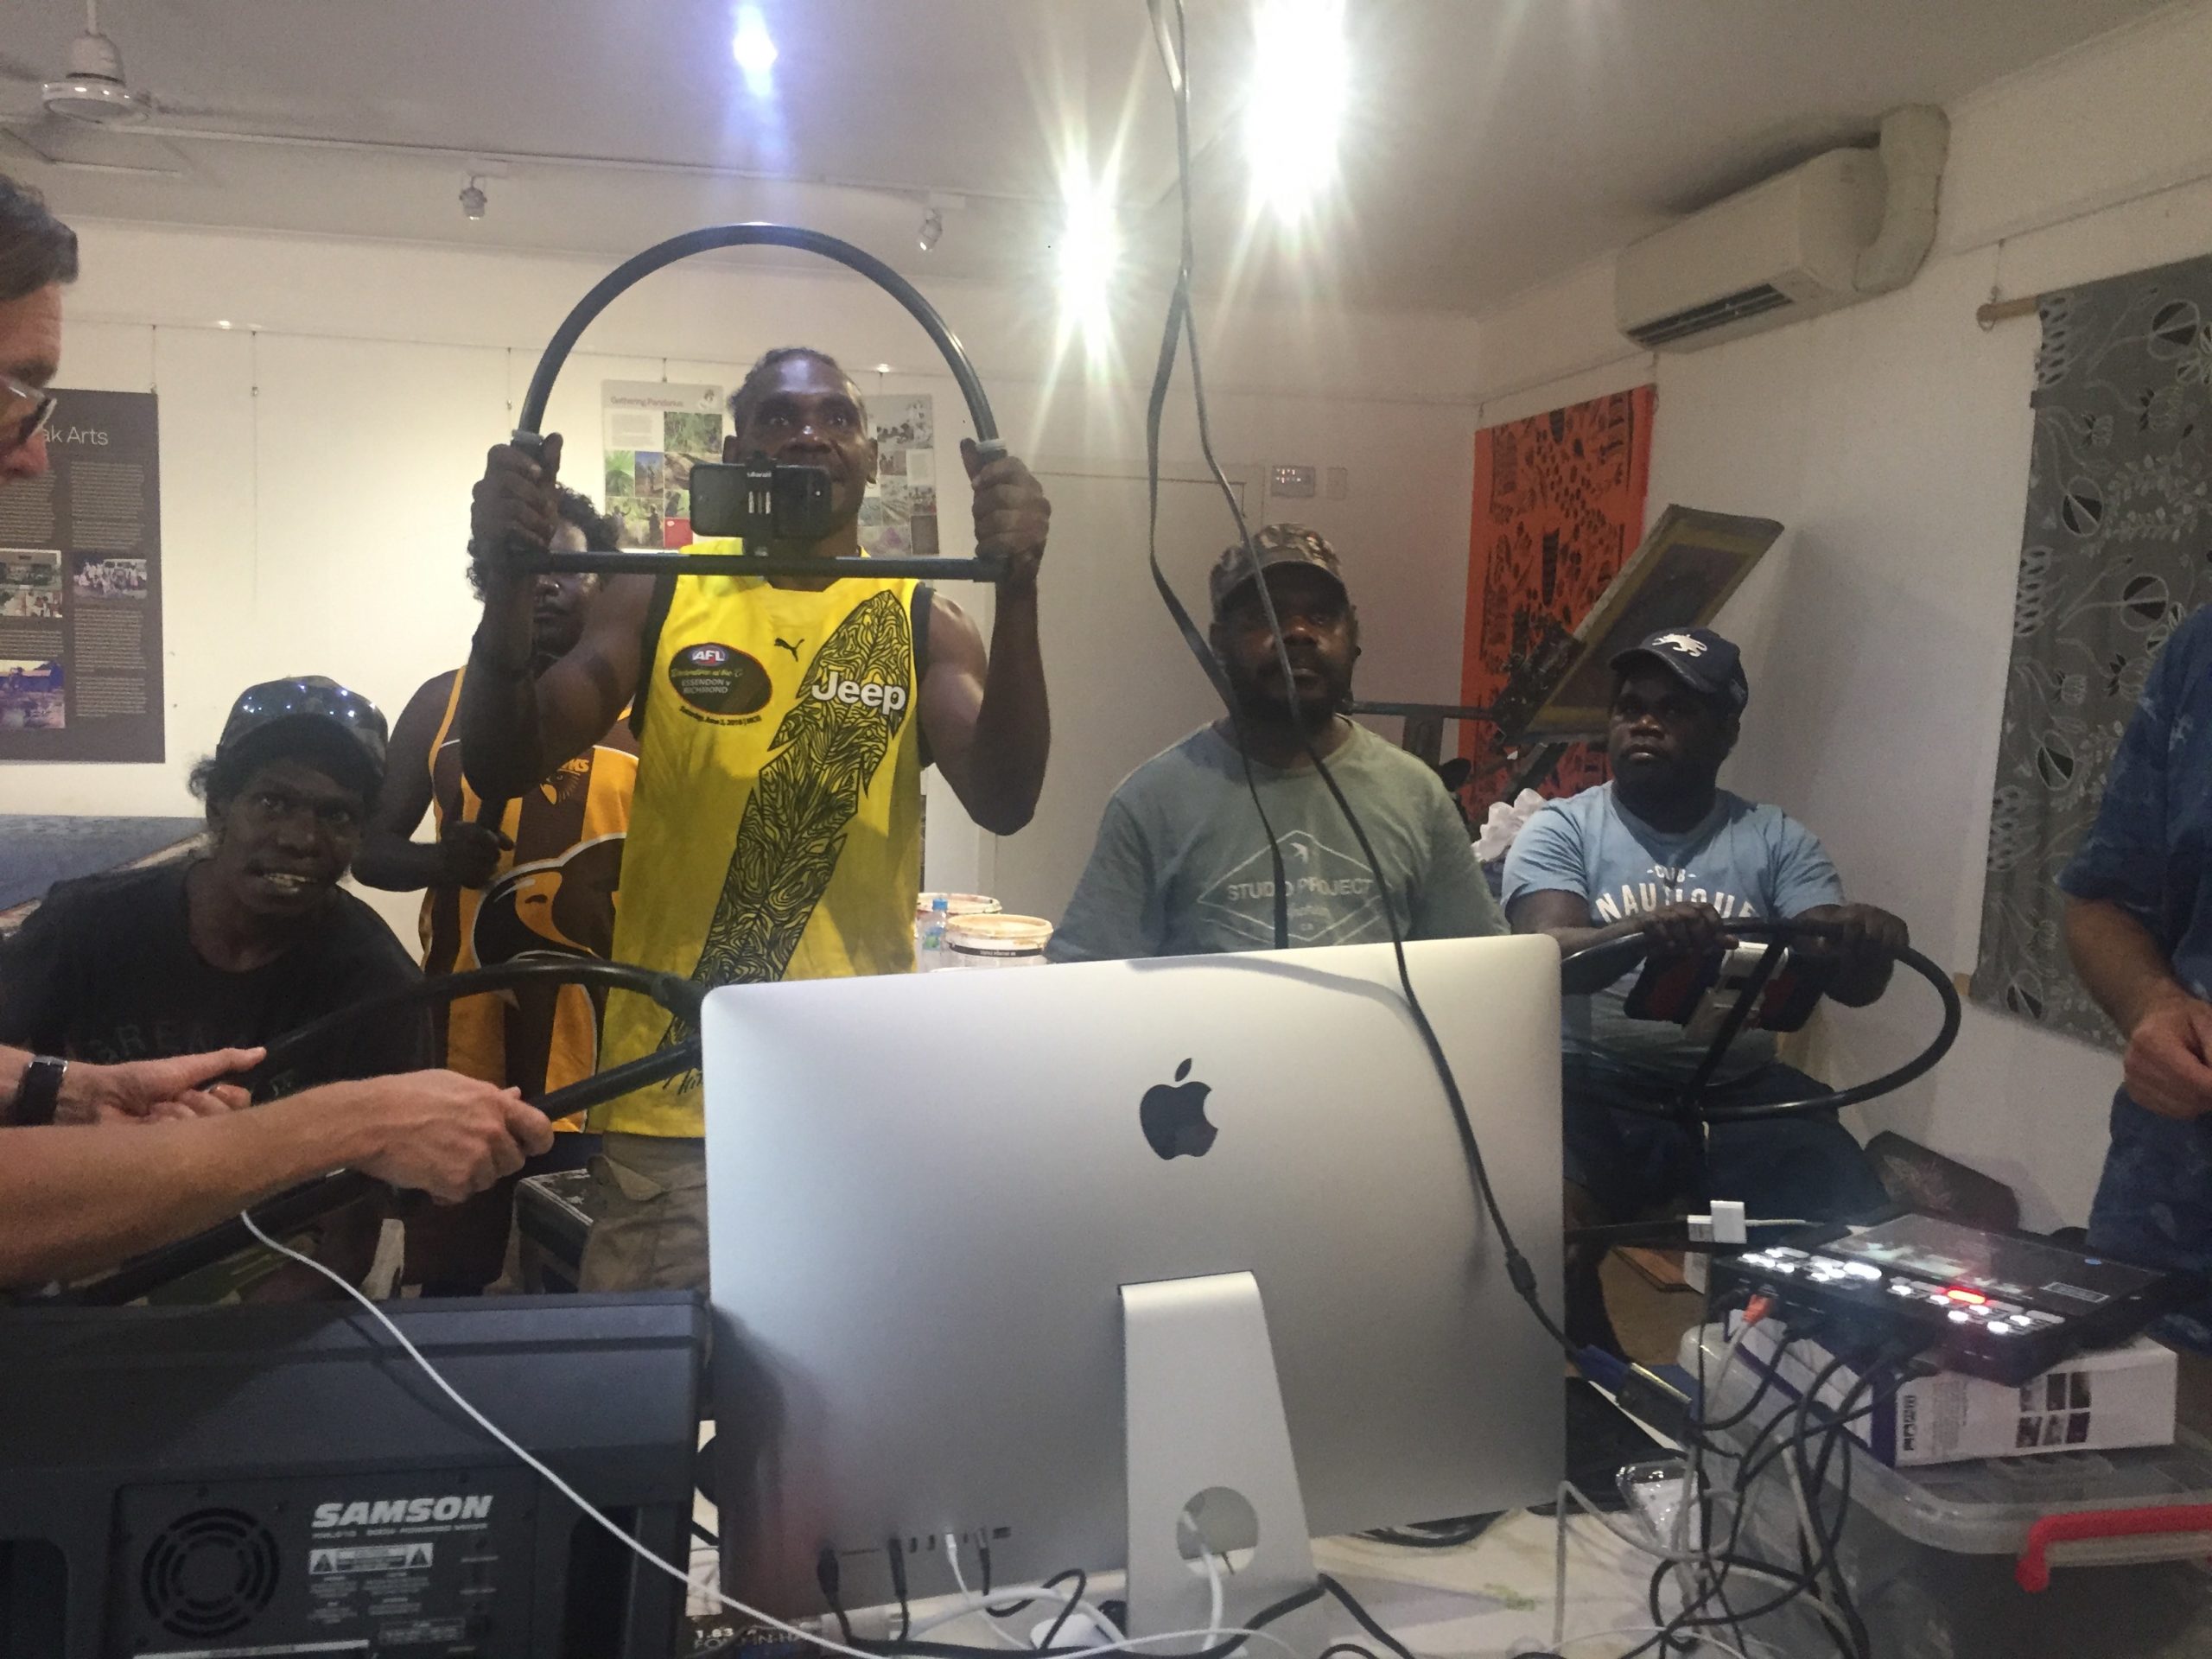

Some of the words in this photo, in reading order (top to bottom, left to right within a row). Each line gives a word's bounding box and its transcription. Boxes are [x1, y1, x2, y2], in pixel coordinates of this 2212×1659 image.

[67, 426, 109, 446] Arts
[692, 649, 725, 662] AFL
[681, 677, 725, 687] ESSENDON
[683, 685, 729, 695] RICHMOND
[811, 671, 906, 715] Jeep
[1227, 880, 1294, 901] STUDO
[311, 1495, 494, 1529] SAMSON
